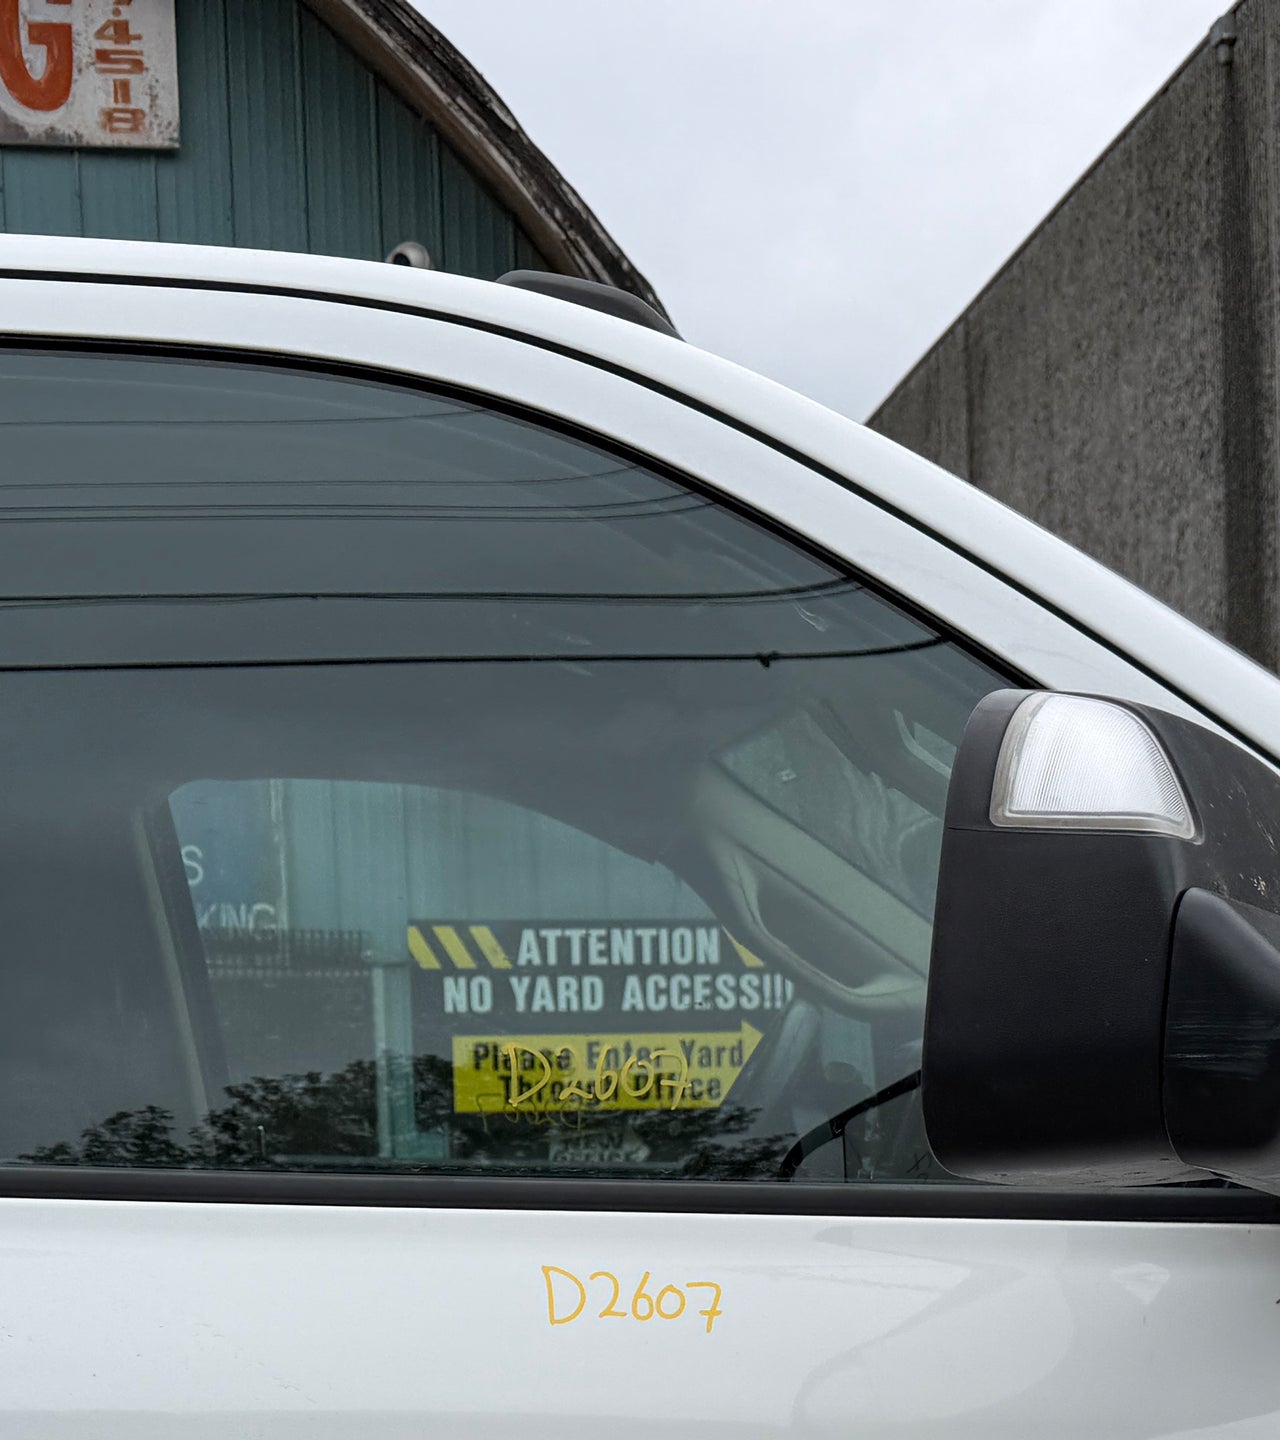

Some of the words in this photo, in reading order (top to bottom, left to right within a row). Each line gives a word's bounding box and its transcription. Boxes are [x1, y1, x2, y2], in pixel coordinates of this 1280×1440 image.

[516, 926, 720, 967] ATTENTION
[442, 975, 493, 1014] NO
[509, 974, 604, 1013] YARD
[587, 1039, 665, 1071] Enter
[679, 1039, 745, 1069] Yard
[501, 1042, 693, 1111] D2607
[541, 1265, 723, 1333] D2607
